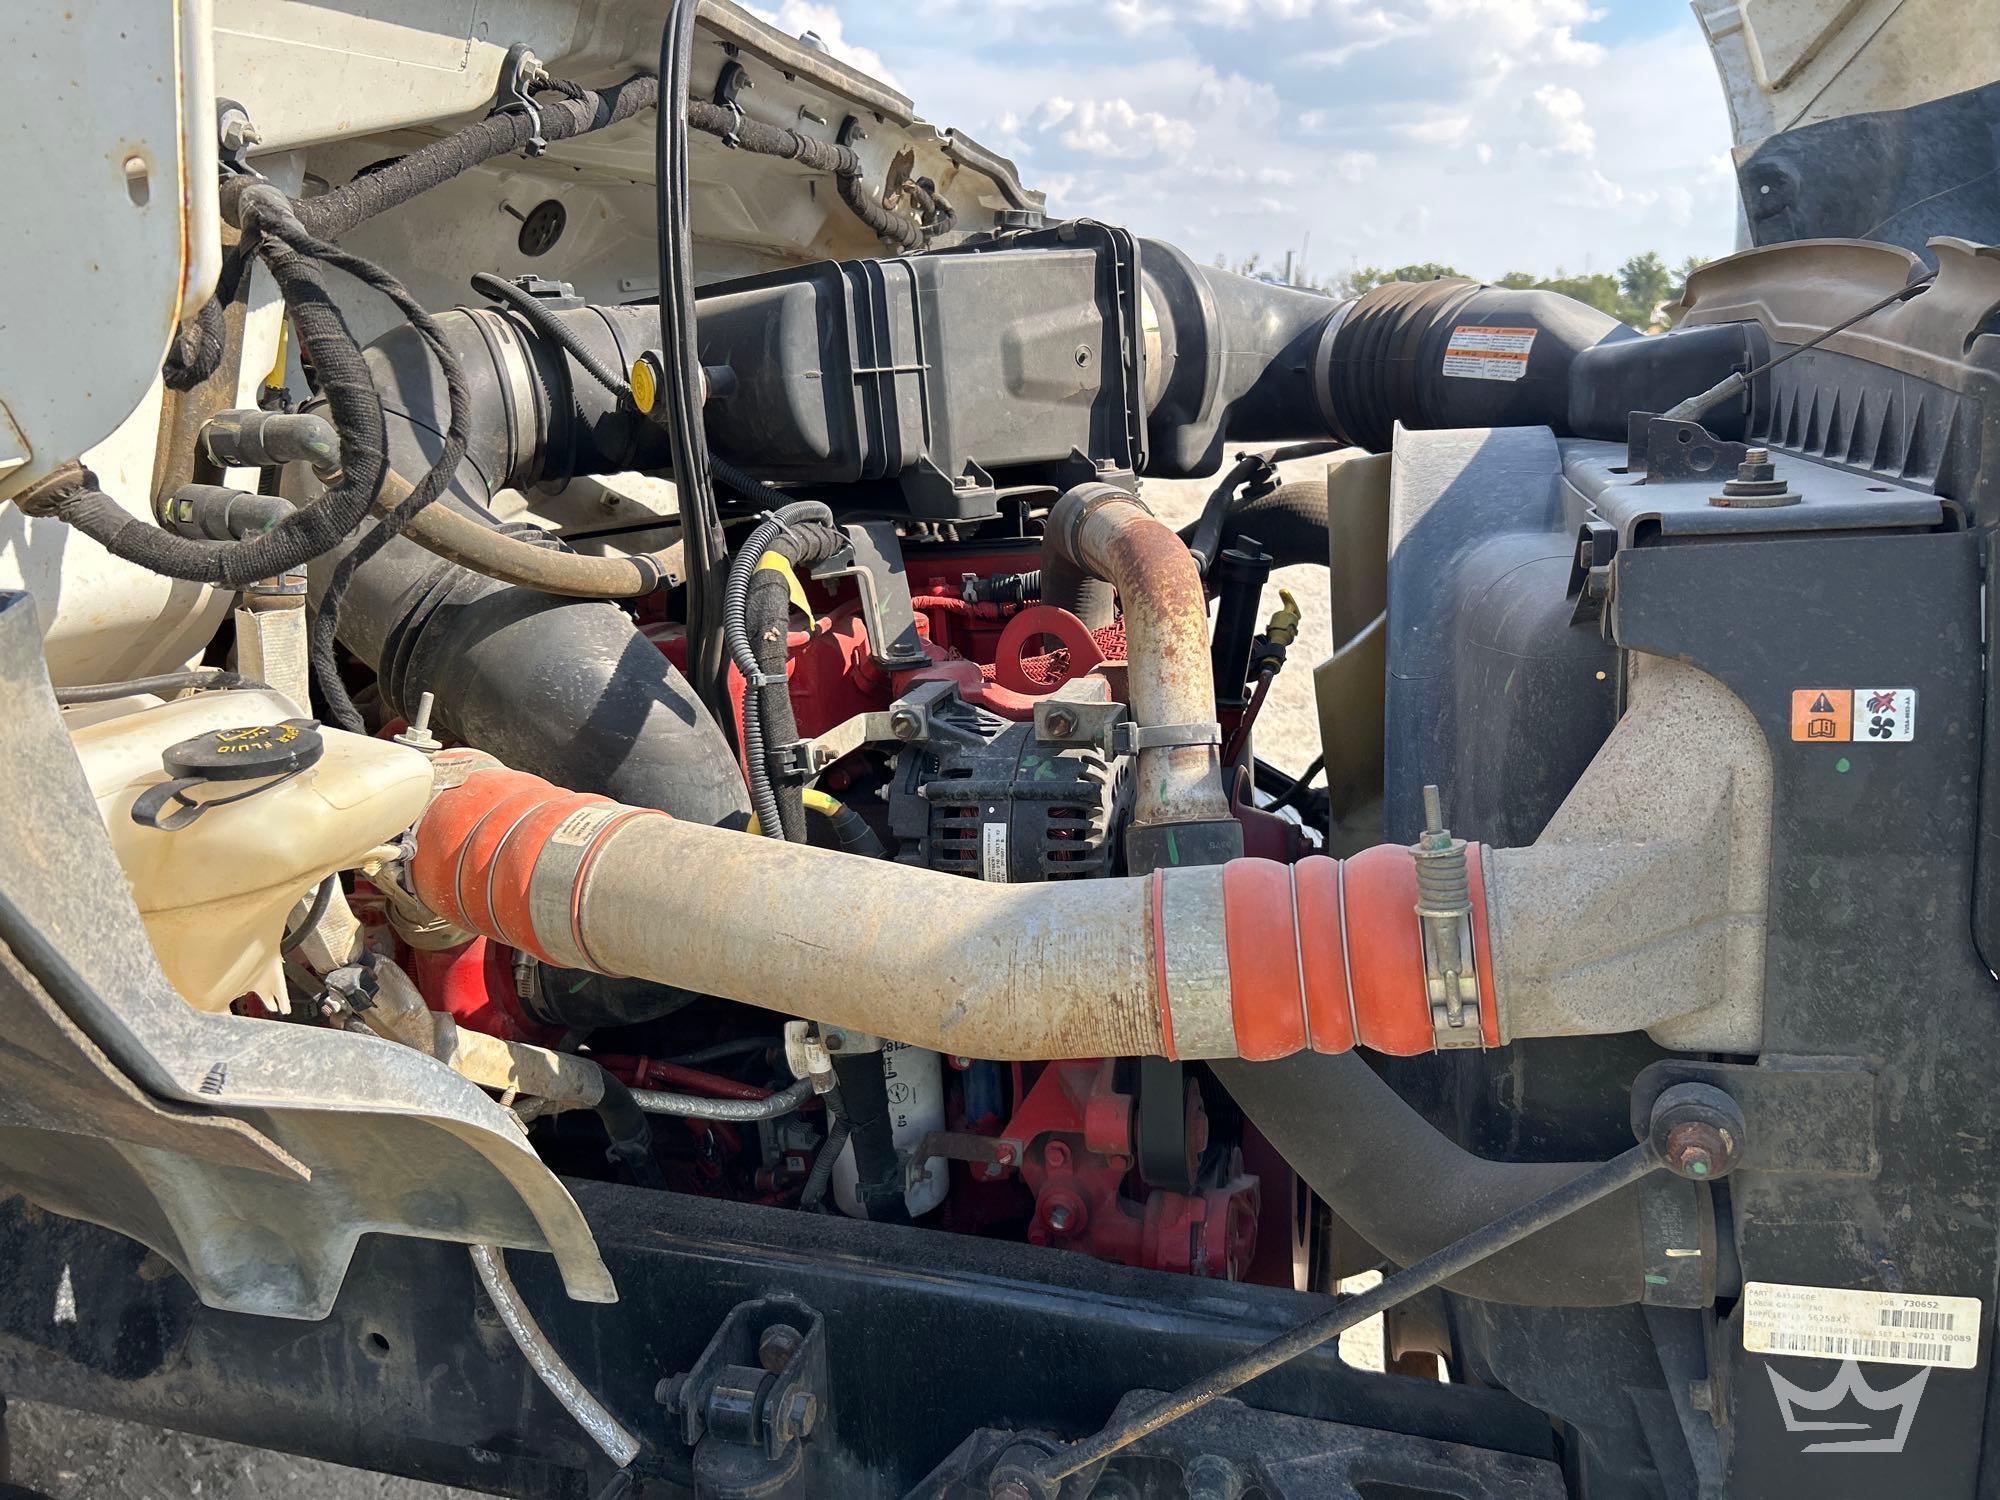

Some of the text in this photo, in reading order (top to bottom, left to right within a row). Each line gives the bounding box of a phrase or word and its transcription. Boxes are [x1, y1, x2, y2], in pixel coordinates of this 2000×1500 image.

[217, 741, 272, 753] FLUID
[1903, 1299, 1939, 1309] 730652
[1941, 1333, 1972, 1343] 00089
